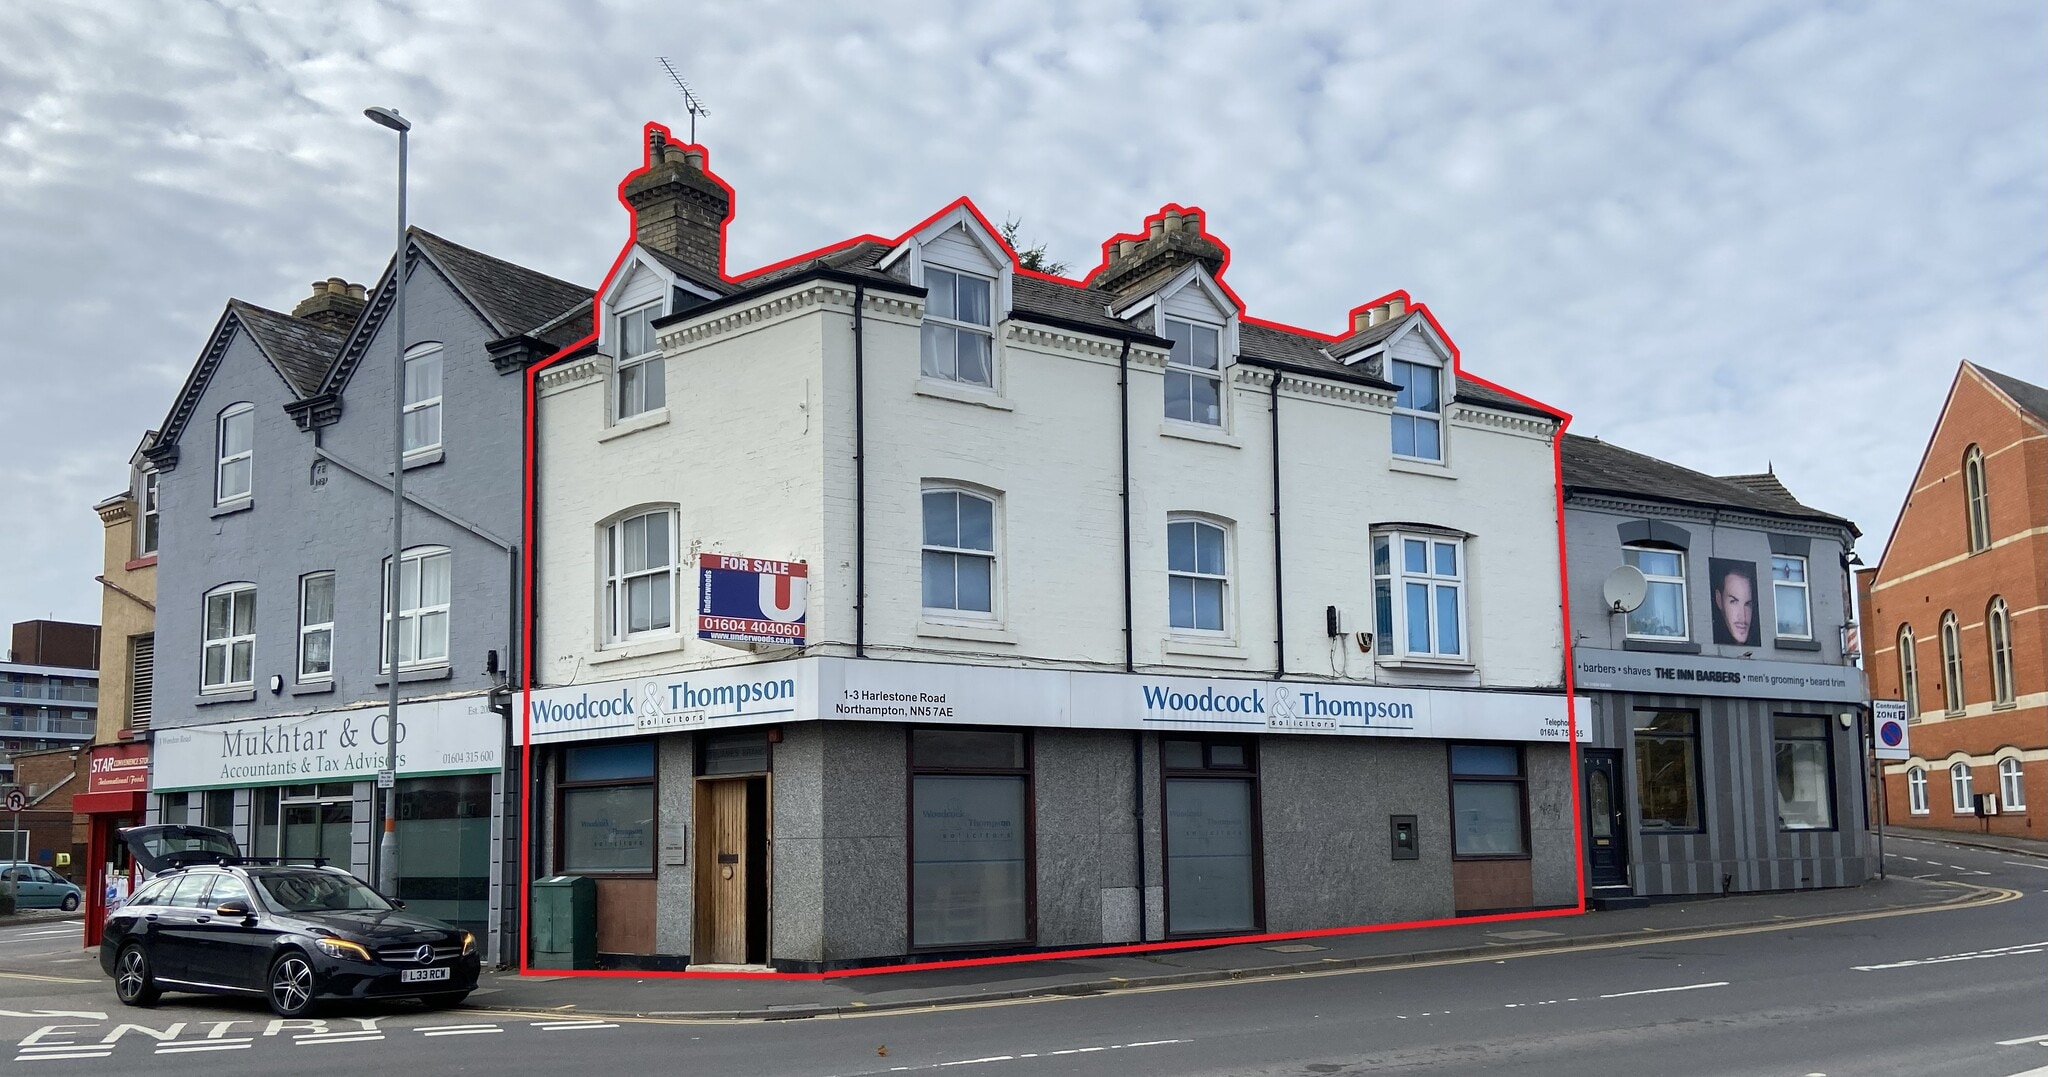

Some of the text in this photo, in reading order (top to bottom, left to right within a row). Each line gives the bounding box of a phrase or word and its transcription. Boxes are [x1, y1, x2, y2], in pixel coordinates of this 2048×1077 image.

[720, 556, 789, 575] FOR SALE
[703, 570, 712, 614] Underwoods
[704, 618, 801, 636] 01604 404060
[710, 632, 795, 645] www.underwoods.co.uk
[1583, 662, 1652, 676] barbers shaves
[1655, 667, 1741, 684] THE INN BARBERS
[1747, 674, 1846, 688] men's grooming beard trim
[531, 678, 795, 724] Woodcock & Thompson
[843, 690, 946, 703] 1-3 Harlestone Road
[835, 703, 953, 717] Northampton, NN5 7AE
[1142, 685, 1414, 725] Woodcock & Thompson
[1875, 702, 1905, 710] Controlled
[640, 714, 704, 726] solicitors
[1876, 711, 1898, 719] ZONE
[1271, 718, 1335, 729] solicitors
[221, 714, 406, 759] Mukhtar & Co
[1540, 729, 1559, 737] 01604
[442, 750, 494, 764] 01604 315 600
[91, 757, 115, 773] STAR
[220, 759, 297, 779] Accountants
[301, 756, 311, 773] &
[315, 755, 340, 772] Tax
[130, 775, 145, 784] Foods
[410, 969, 446, 980] L33 RCW
[17, 1016, 398, 1046] ENTRY
